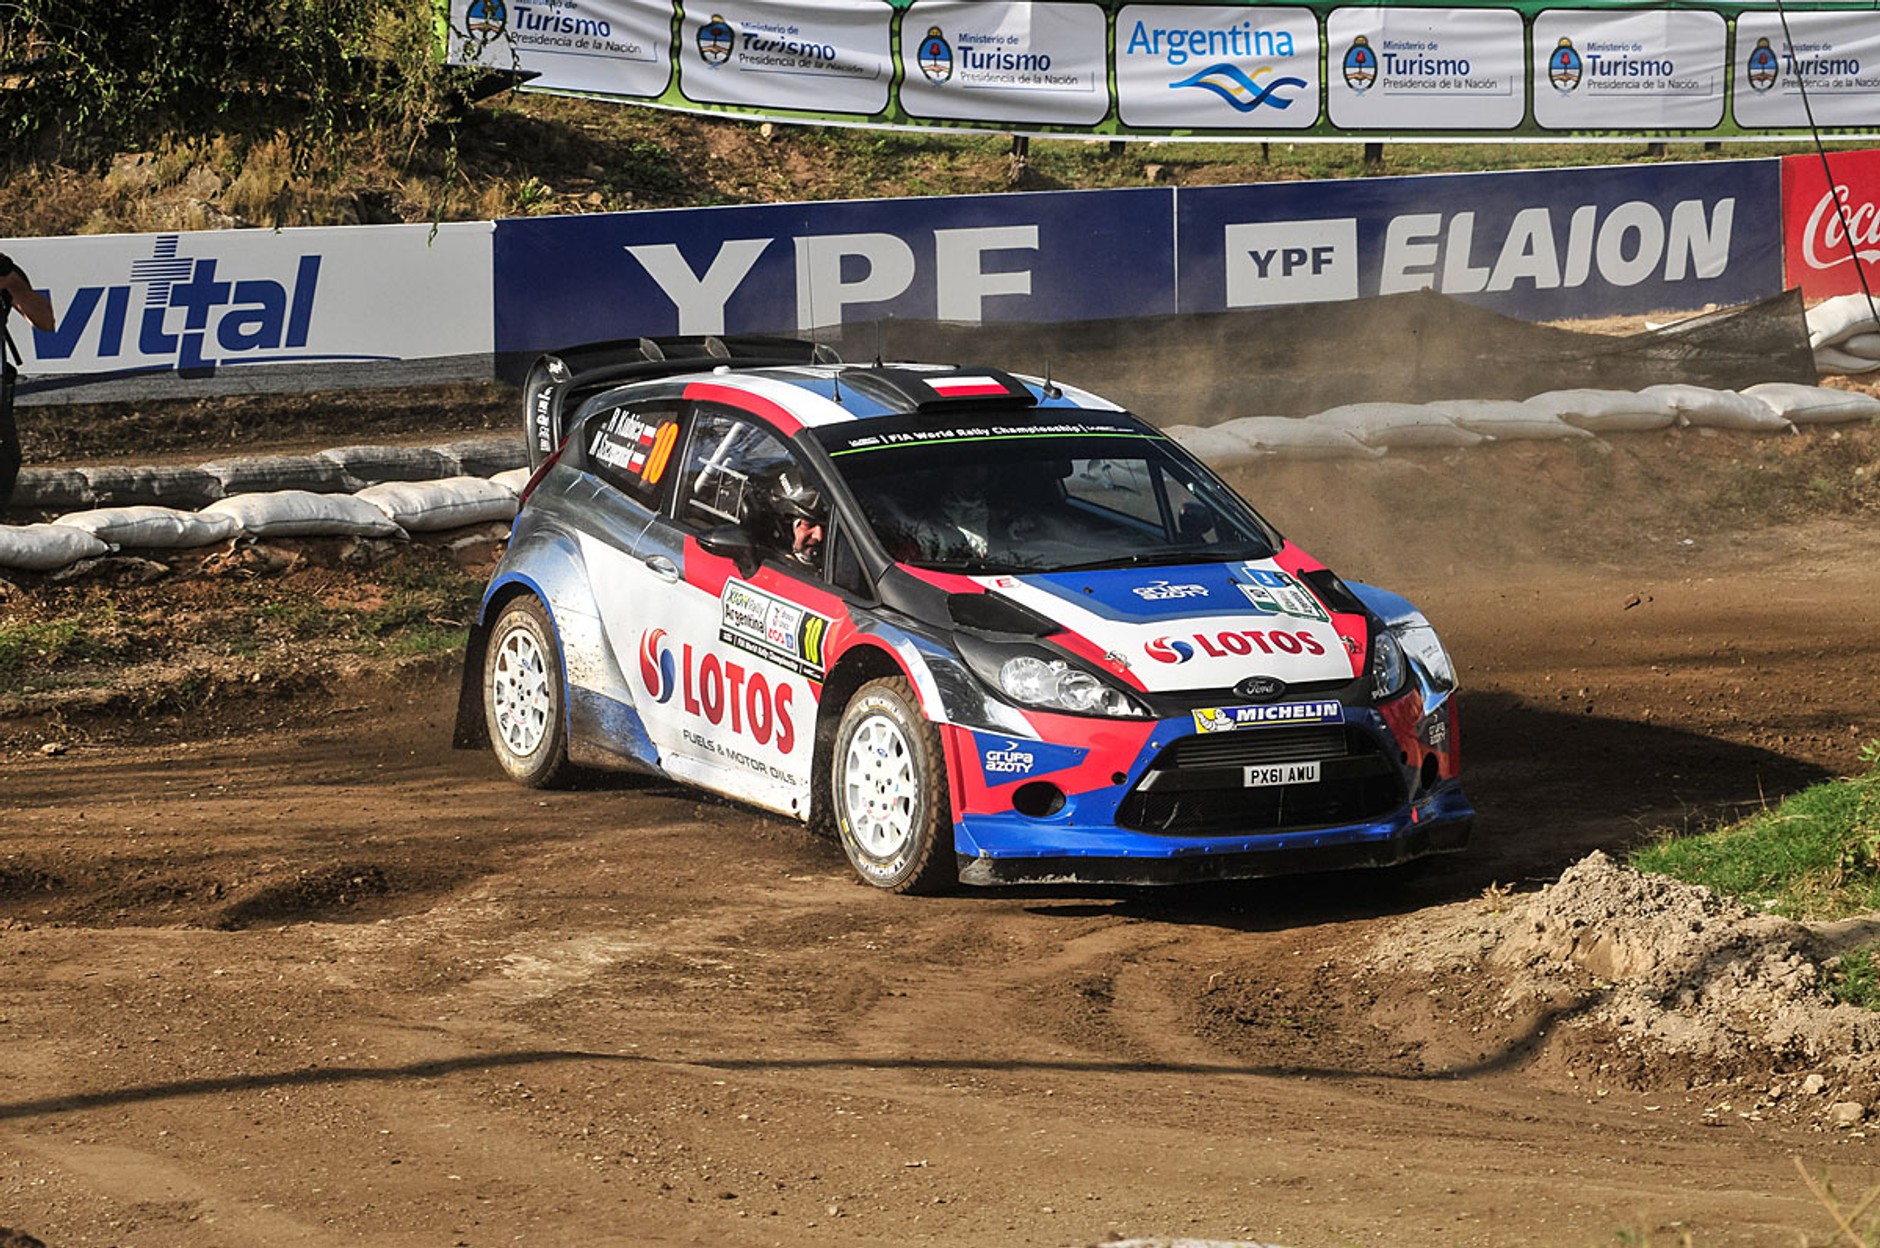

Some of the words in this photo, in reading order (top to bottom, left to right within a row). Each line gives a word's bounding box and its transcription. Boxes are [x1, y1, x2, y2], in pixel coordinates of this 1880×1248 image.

[514, 6, 611, 38] Turismo
[787, 25, 799, 35] de
[511, 32, 572, 47] Presidencia
[575, 38, 589, 49] de
[592, 39, 603, 50] la
[607, 41, 642, 54] Nación
[742, 32, 836, 61] Turismo
[958, 33, 1005, 45] Ministerio
[1007, 34, 1019, 45] de
[1127, 20, 1295, 65] Argentina
[1383, 40, 1425, 51] Ministerio
[1427, 41, 1438, 51] de
[1587, 42, 1630, 52] Ministerio
[1631, 42, 1643, 52] de
[1821, 42, 1832, 51] de
[739, 53, 795, 67] Presidencia
[799, 57, 811, 68] de
[814, 58, 823, 69] la
[958, 46, 1050, 72] Turismo
[1382, 53, 1470, 76] Turismo
[1586, 55, 1673, 76] Turismo
[1782, 54, 1860, 76] Turismo
[960, 71, 1015, 84] Presidencia
[1018, 73, 1032, 84] de
[1034, 73, 1042, 84] la
[1045, 73, 1078, 85] Nación
[1383, 78, 1437, 89] Presidencia
[1439, 78, 1452, 89] de
[1454, 78, 1463, 89] la
[1465, 78, 1497, 89] Nación
[1587, 79, 1640, 90] Presidencia
[1643, 79, 1655, 90] de
[1657, 79, 1665, 90] la
[1668, 79, 1699, 90] Nación
[1832, 79, 1843, 88] de
[1845, 79, 1853, 88] la
[1379, 197, 1735, 296] ELAION
[1248, 246, 1335, 279] YPF
[624, 225, 1039, 338] YPF
[33, 236, 322, 379] vittal
[888, 433, 914, 442] FIA
[913, 429, 955, 440] World
[956, 427, 990, 437] Rally
[992, 424, 1081, 434] Championship
[642, 421, 679, 484] 10
[725, 603, 765, 634] Argentina
[804, 616, 823, 665] 10
[1192, 630, 1325, 657] LOTOS
[683, 643, 795, 754] LOTOS
[1246, 681, 1275, 694] Ford
[1236, 703, 1338, 722] MICHELIN
[683, 729, 715, 752] FUELS
[717, 744, 725, 756] &
[725, 748, 767, 775] MOTOR
[769, 766, 797, 786] OILS
[1251, 768, 1282, 784] PX61
[1288, 766, 1314, 782] AWU
